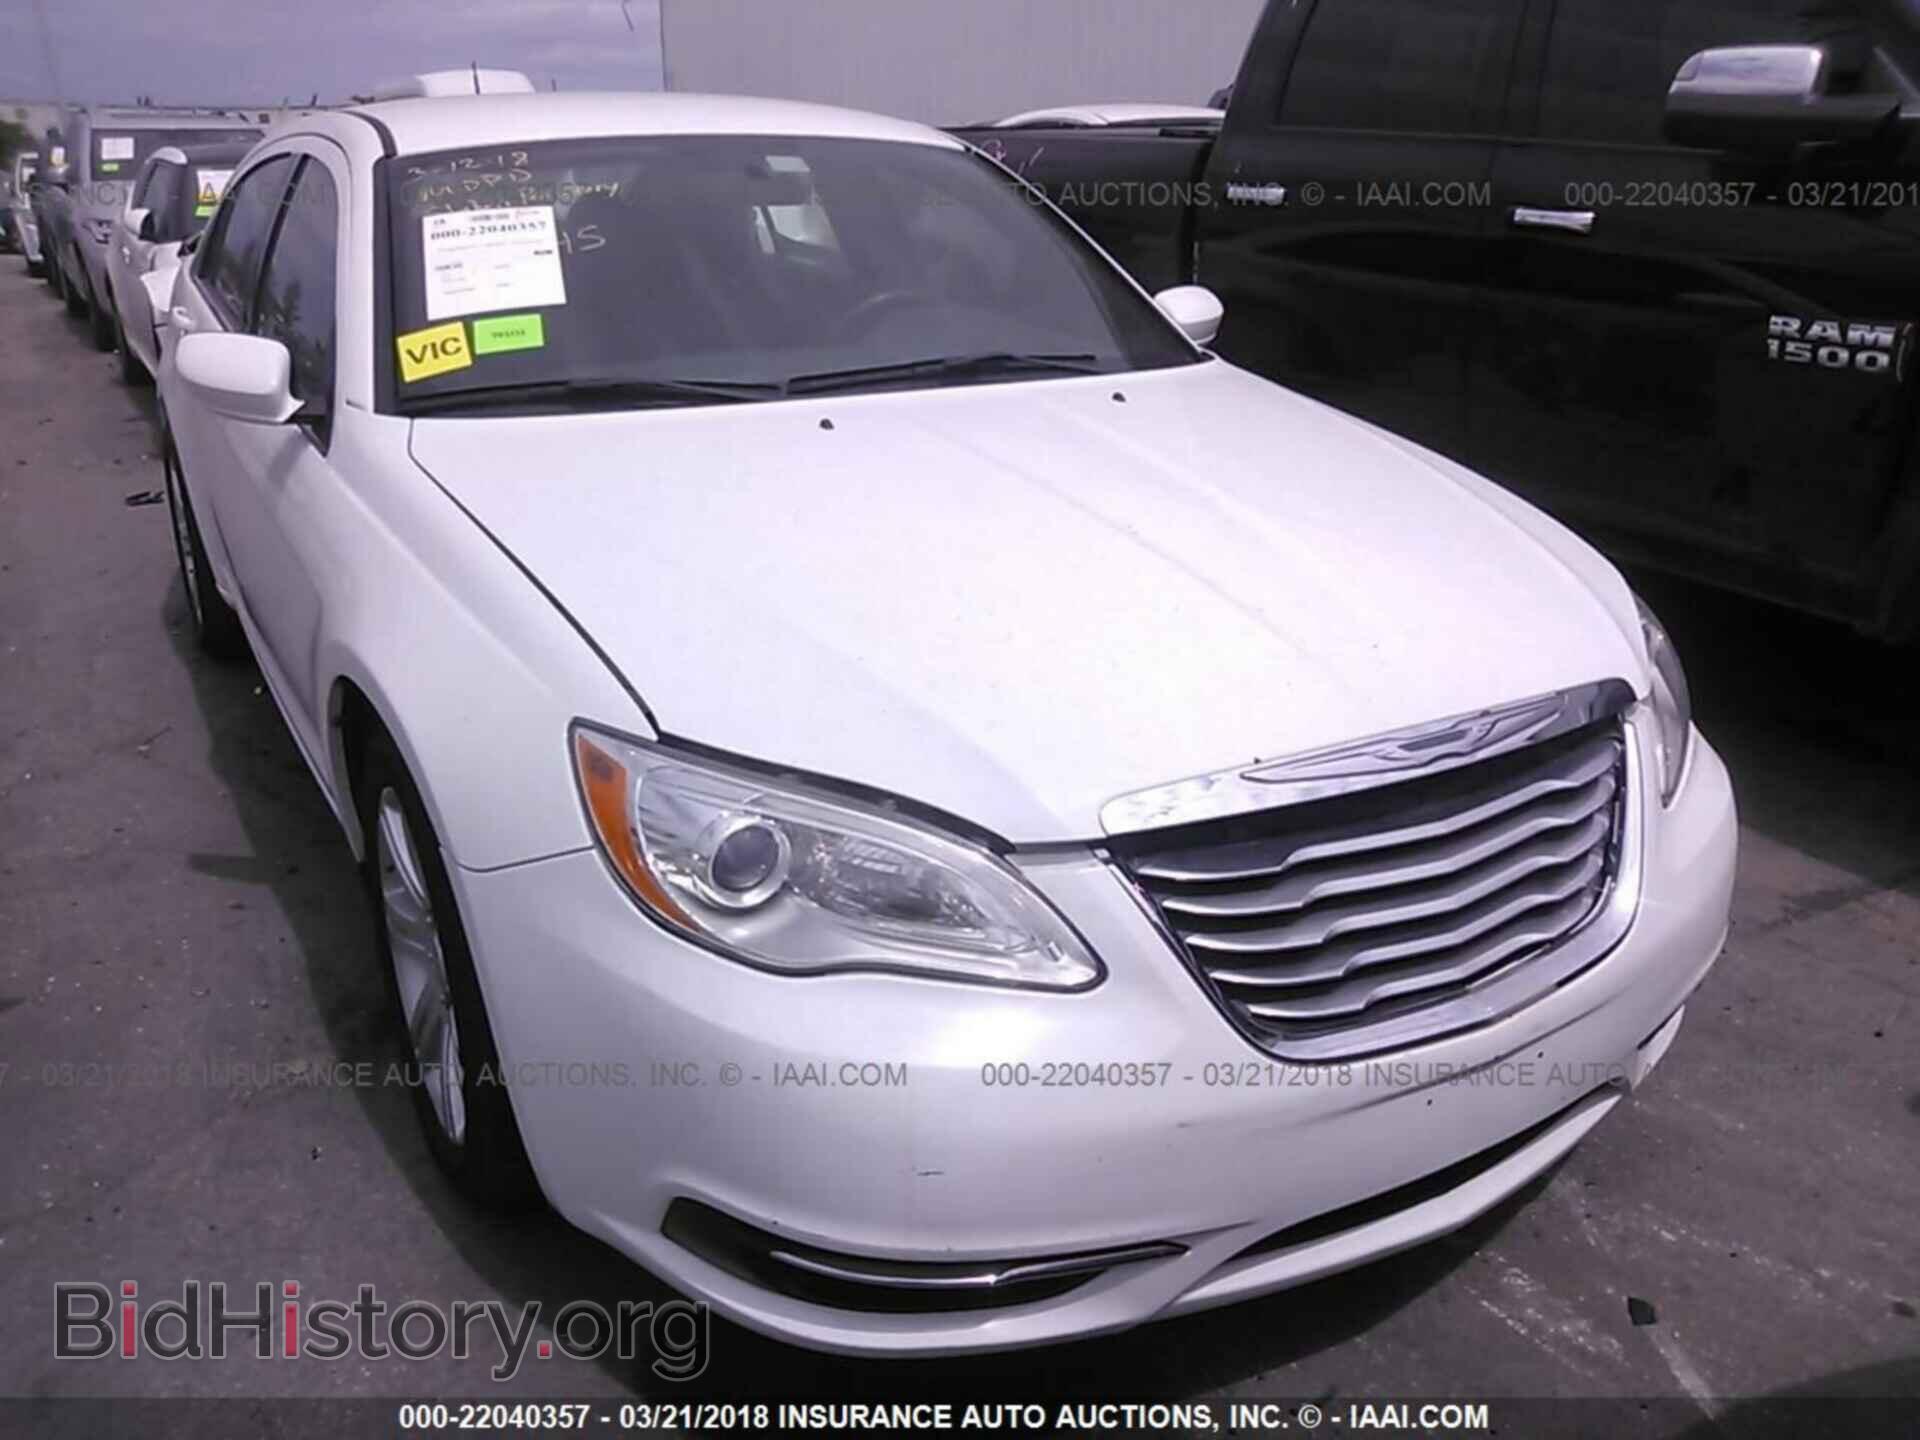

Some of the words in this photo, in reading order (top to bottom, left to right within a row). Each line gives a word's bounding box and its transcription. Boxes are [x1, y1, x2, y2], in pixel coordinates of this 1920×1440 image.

[1768, 315, 1897, 347] RAM
[406, 336, 462, 365] VIC
[1767, 338, 1890, 372] 1500
